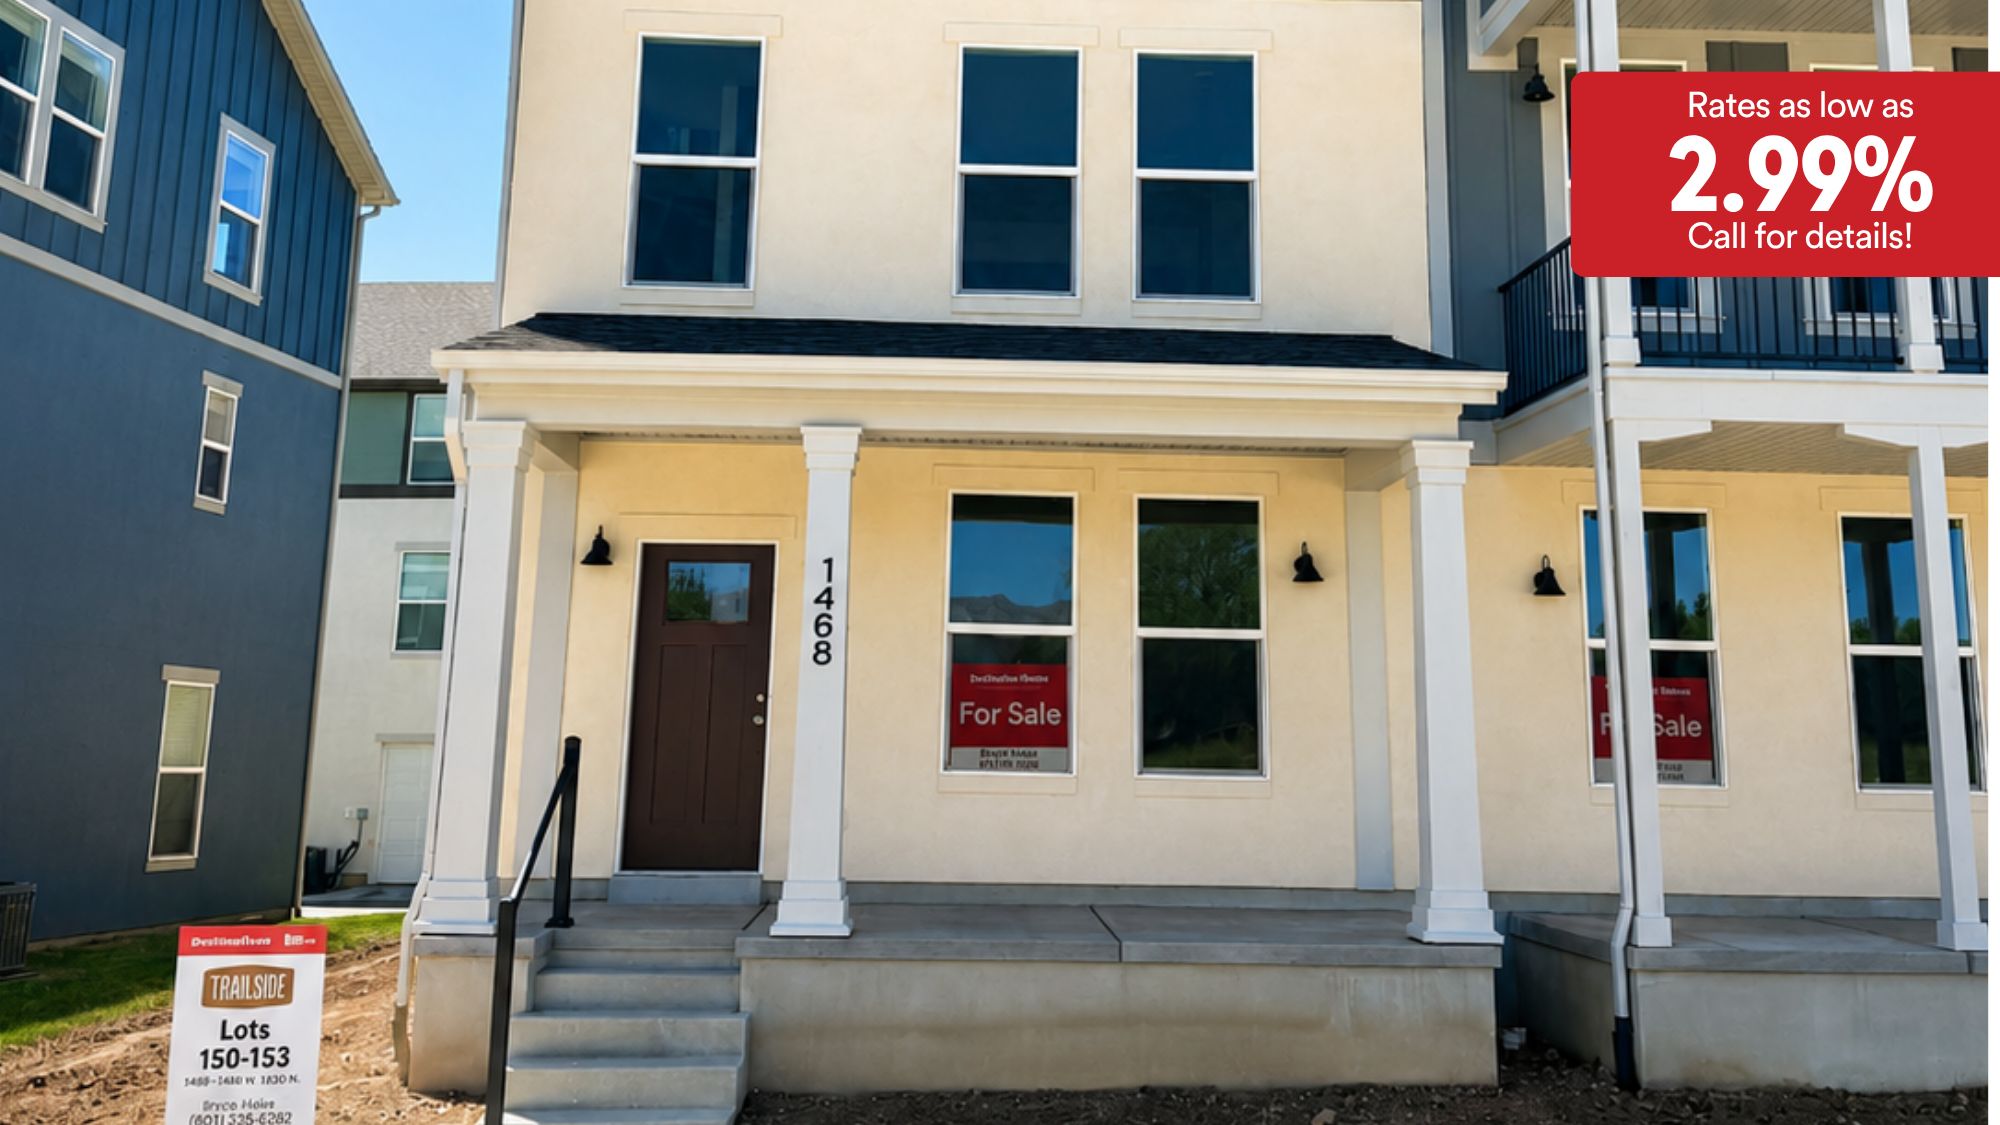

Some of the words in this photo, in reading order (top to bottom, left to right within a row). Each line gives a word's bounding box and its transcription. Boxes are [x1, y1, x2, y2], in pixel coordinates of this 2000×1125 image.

[812, 557, 834, 666] 1468
[960, 701, 1002, 725] For
[1008, 701, 1062, 726] Sale
[1654, 713, 1702, 737] Sale
[210, 973, 287, 1001] TRAILSIDE
[220, 1019, 270, 1041] Lots
[199, 1045, 290, 1070] 150-153
